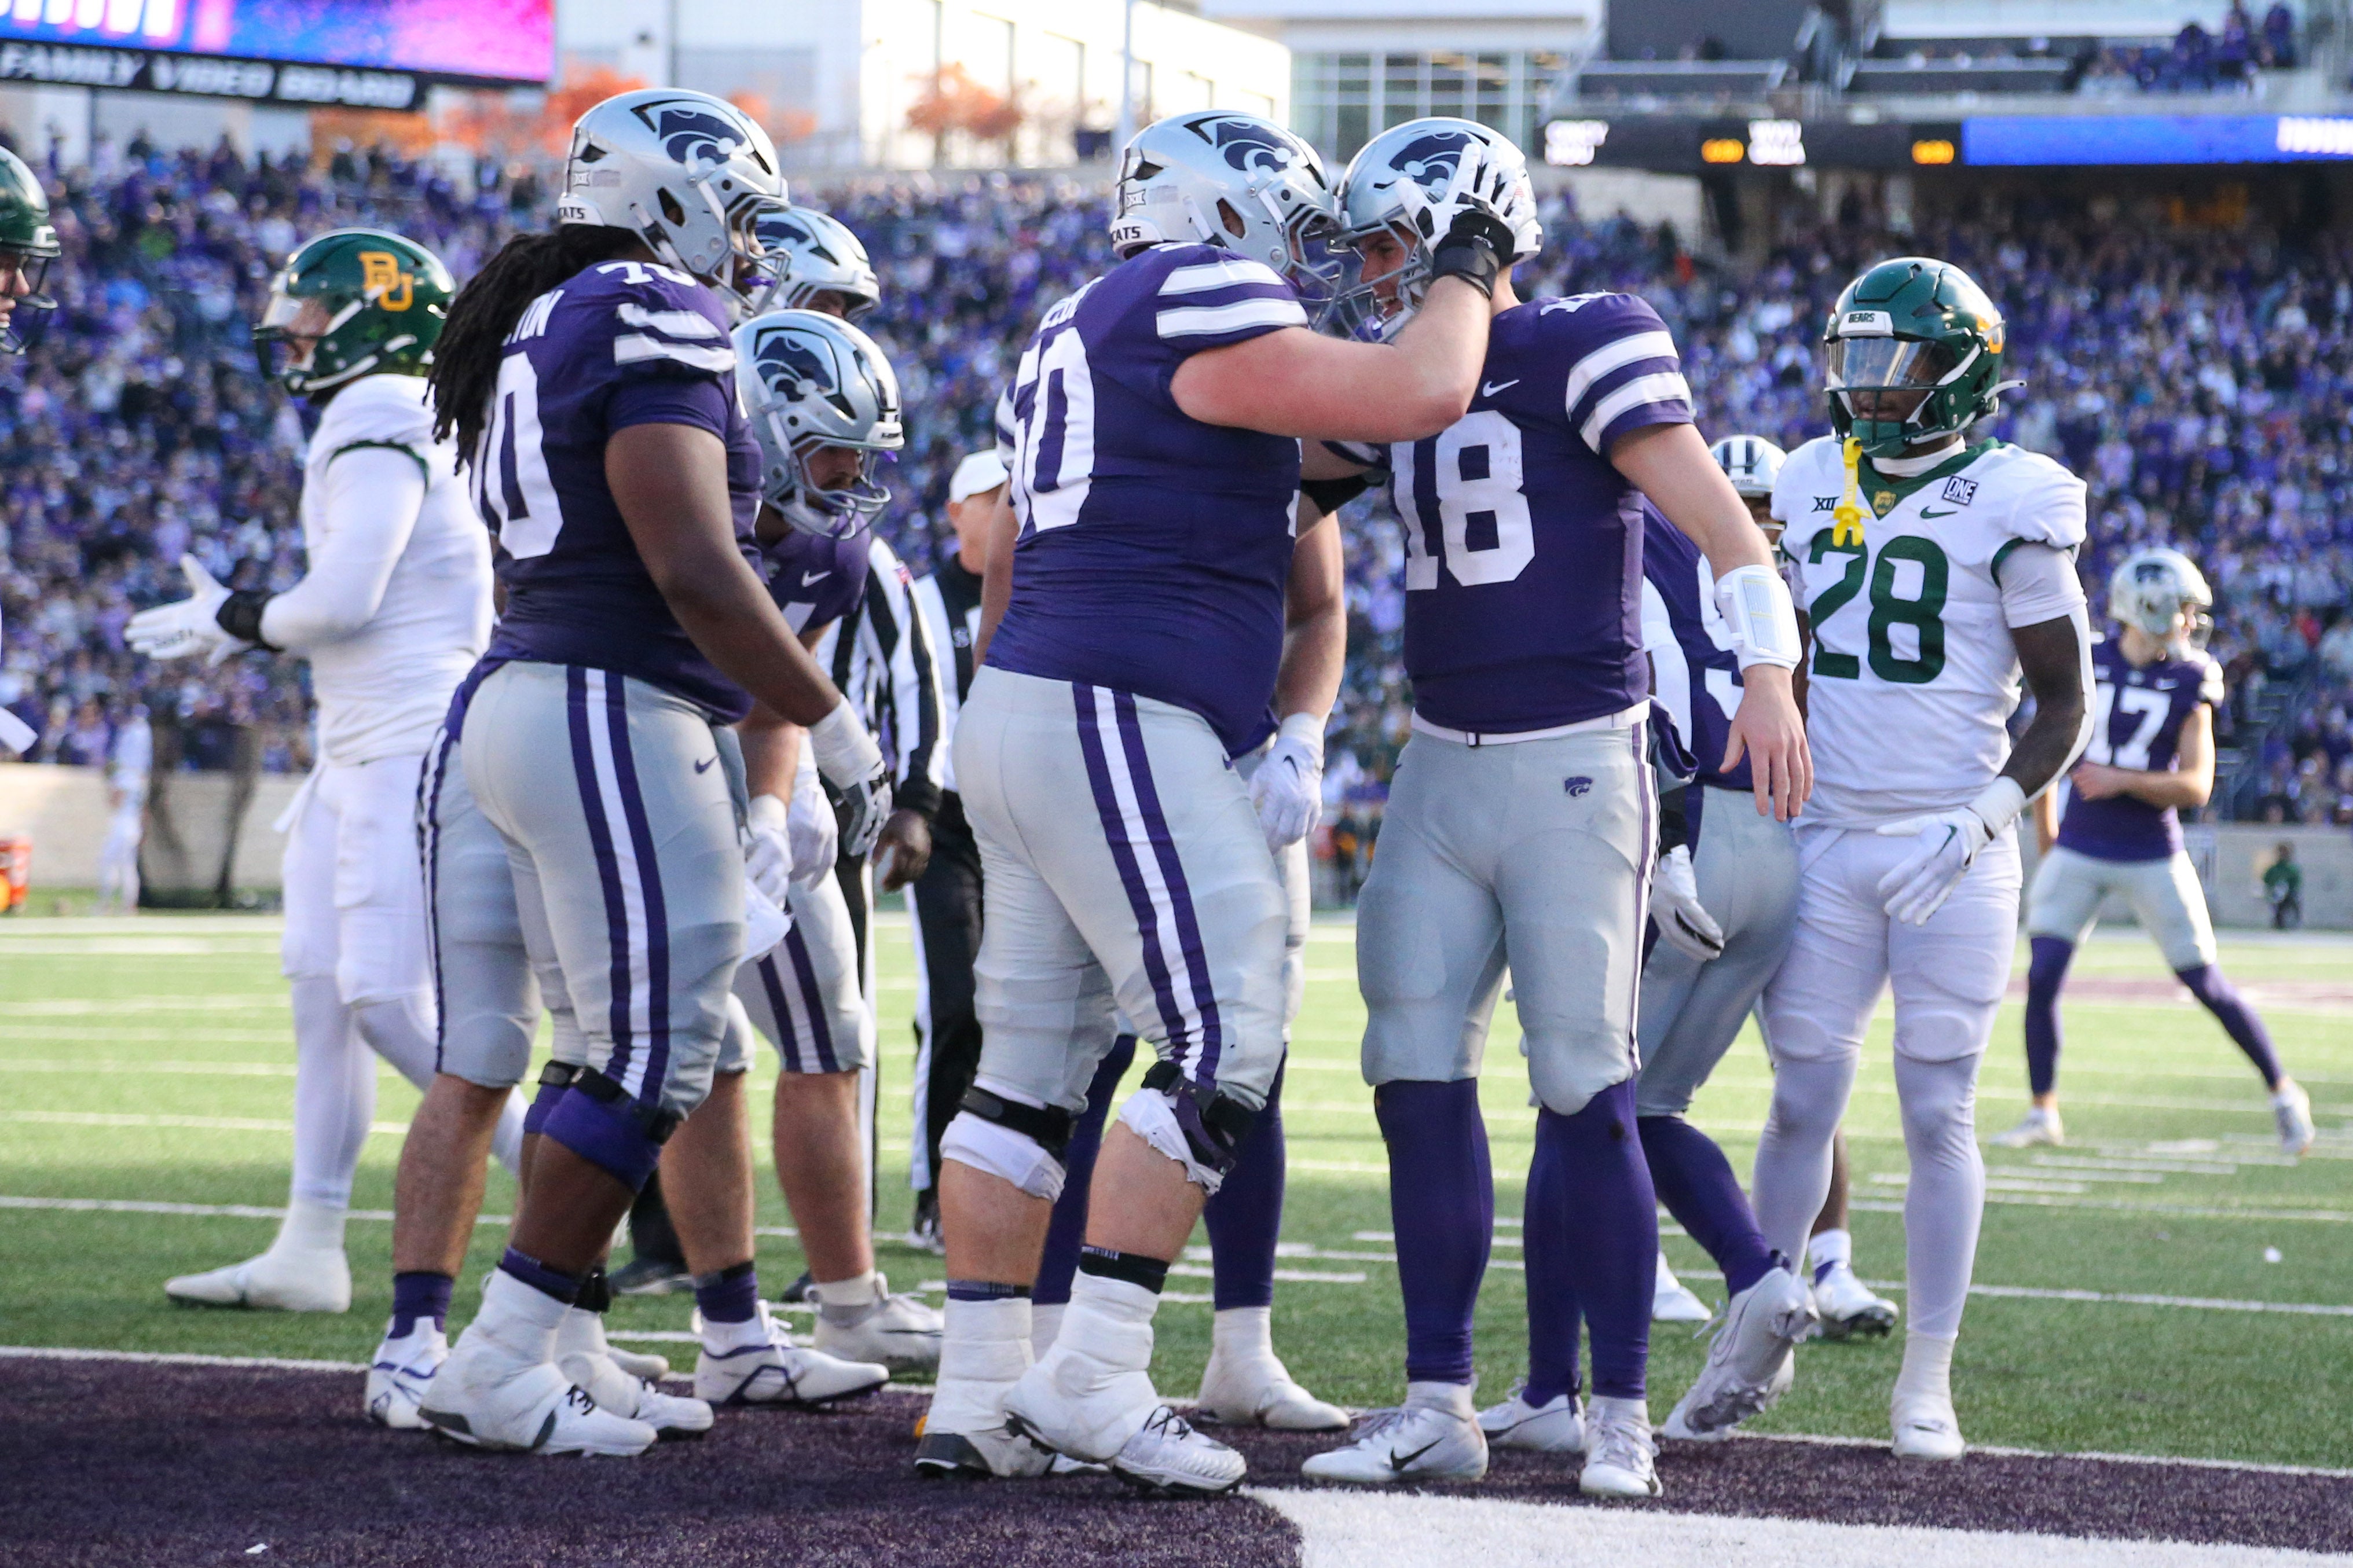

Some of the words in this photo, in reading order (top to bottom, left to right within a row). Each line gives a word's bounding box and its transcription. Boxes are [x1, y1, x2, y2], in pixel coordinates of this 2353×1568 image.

[1, 42, 145, 87] FAMILY
[150, 54, 274, 97] VIDEO
[276, 64, 415, 108] BOARD
[1848, 313, 1875, 323] BEARS
[1390, 409, 1535, 590] 18
[1946, 478, 1977, 500] ONE
[1809, 527, 1949, 684] 28
[2085, 682, 2172, 770] 17
